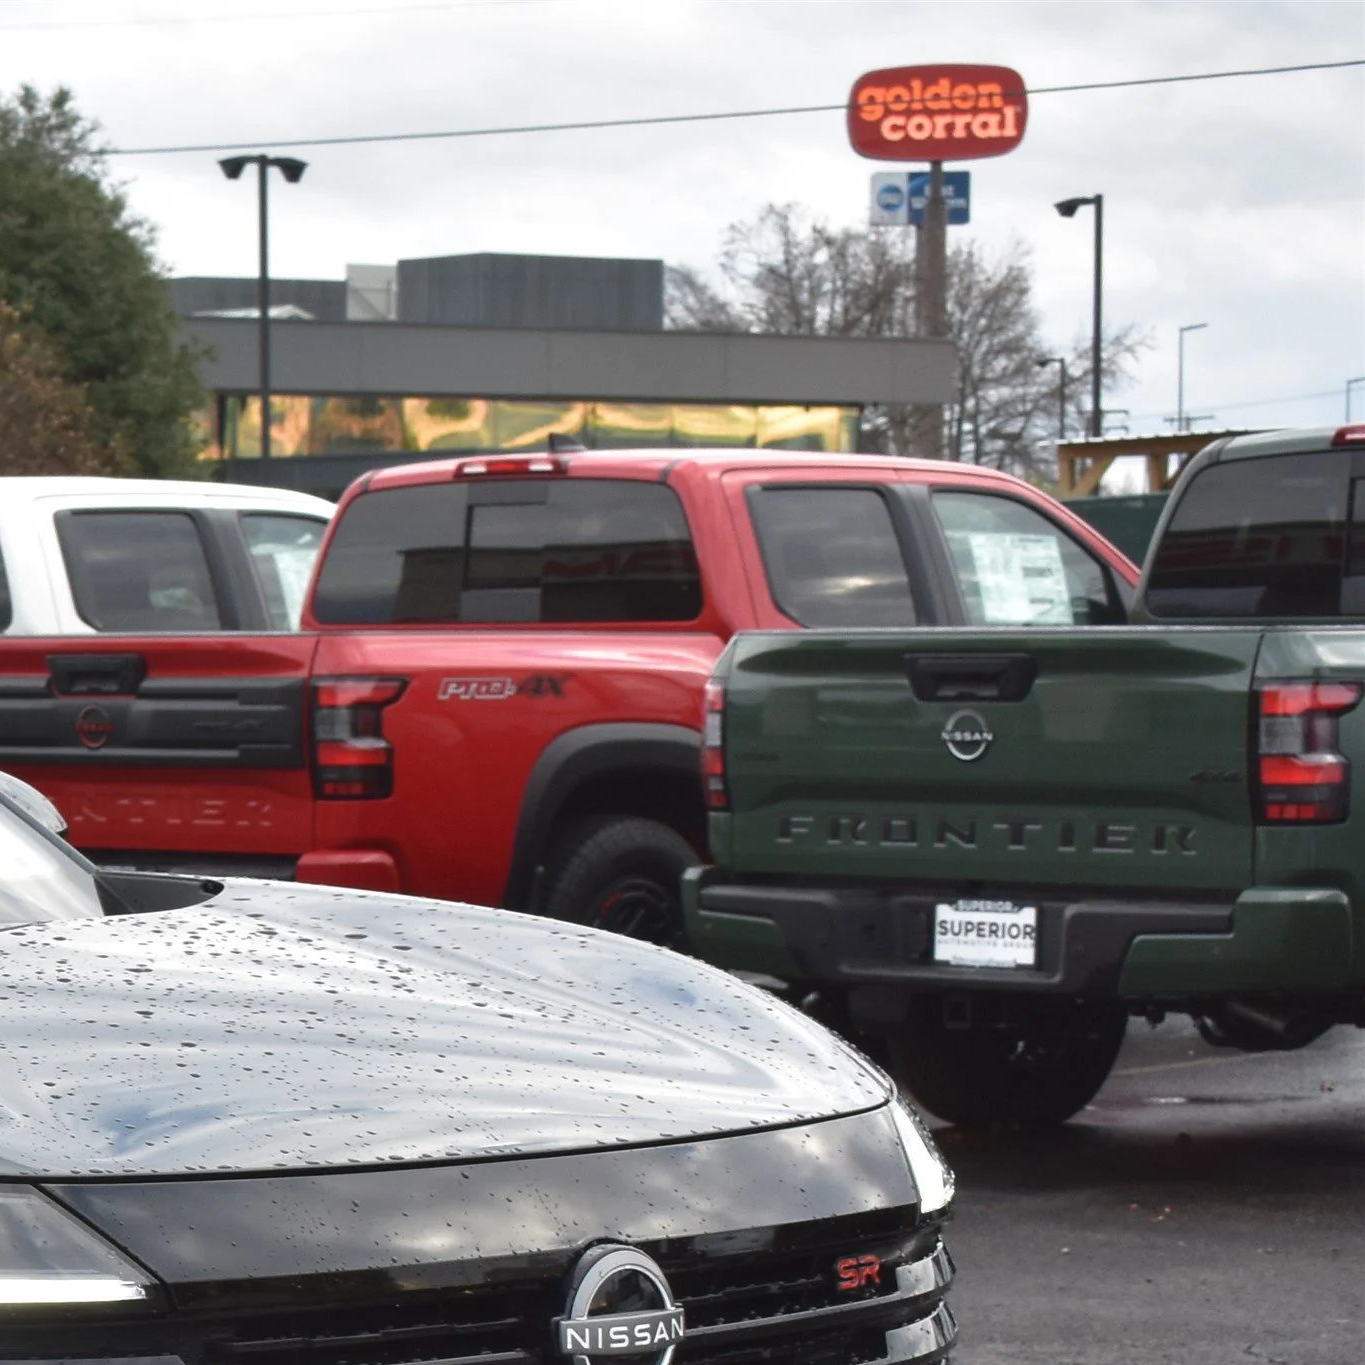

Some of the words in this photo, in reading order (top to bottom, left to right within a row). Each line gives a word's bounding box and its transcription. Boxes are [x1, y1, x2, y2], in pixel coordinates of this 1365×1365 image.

[857, 77, 1005, 121] golden
[880, 105, 1018, 141] corral
[941, 731, 994, 742] NISSAN
[776, 815, 1196, 856] FRONTIER
[938, 919, 1036, 941] SUPERIOR
[836, 1254, 882, 1291] SR
[566, 1315, 684, 1350] NISSAN
